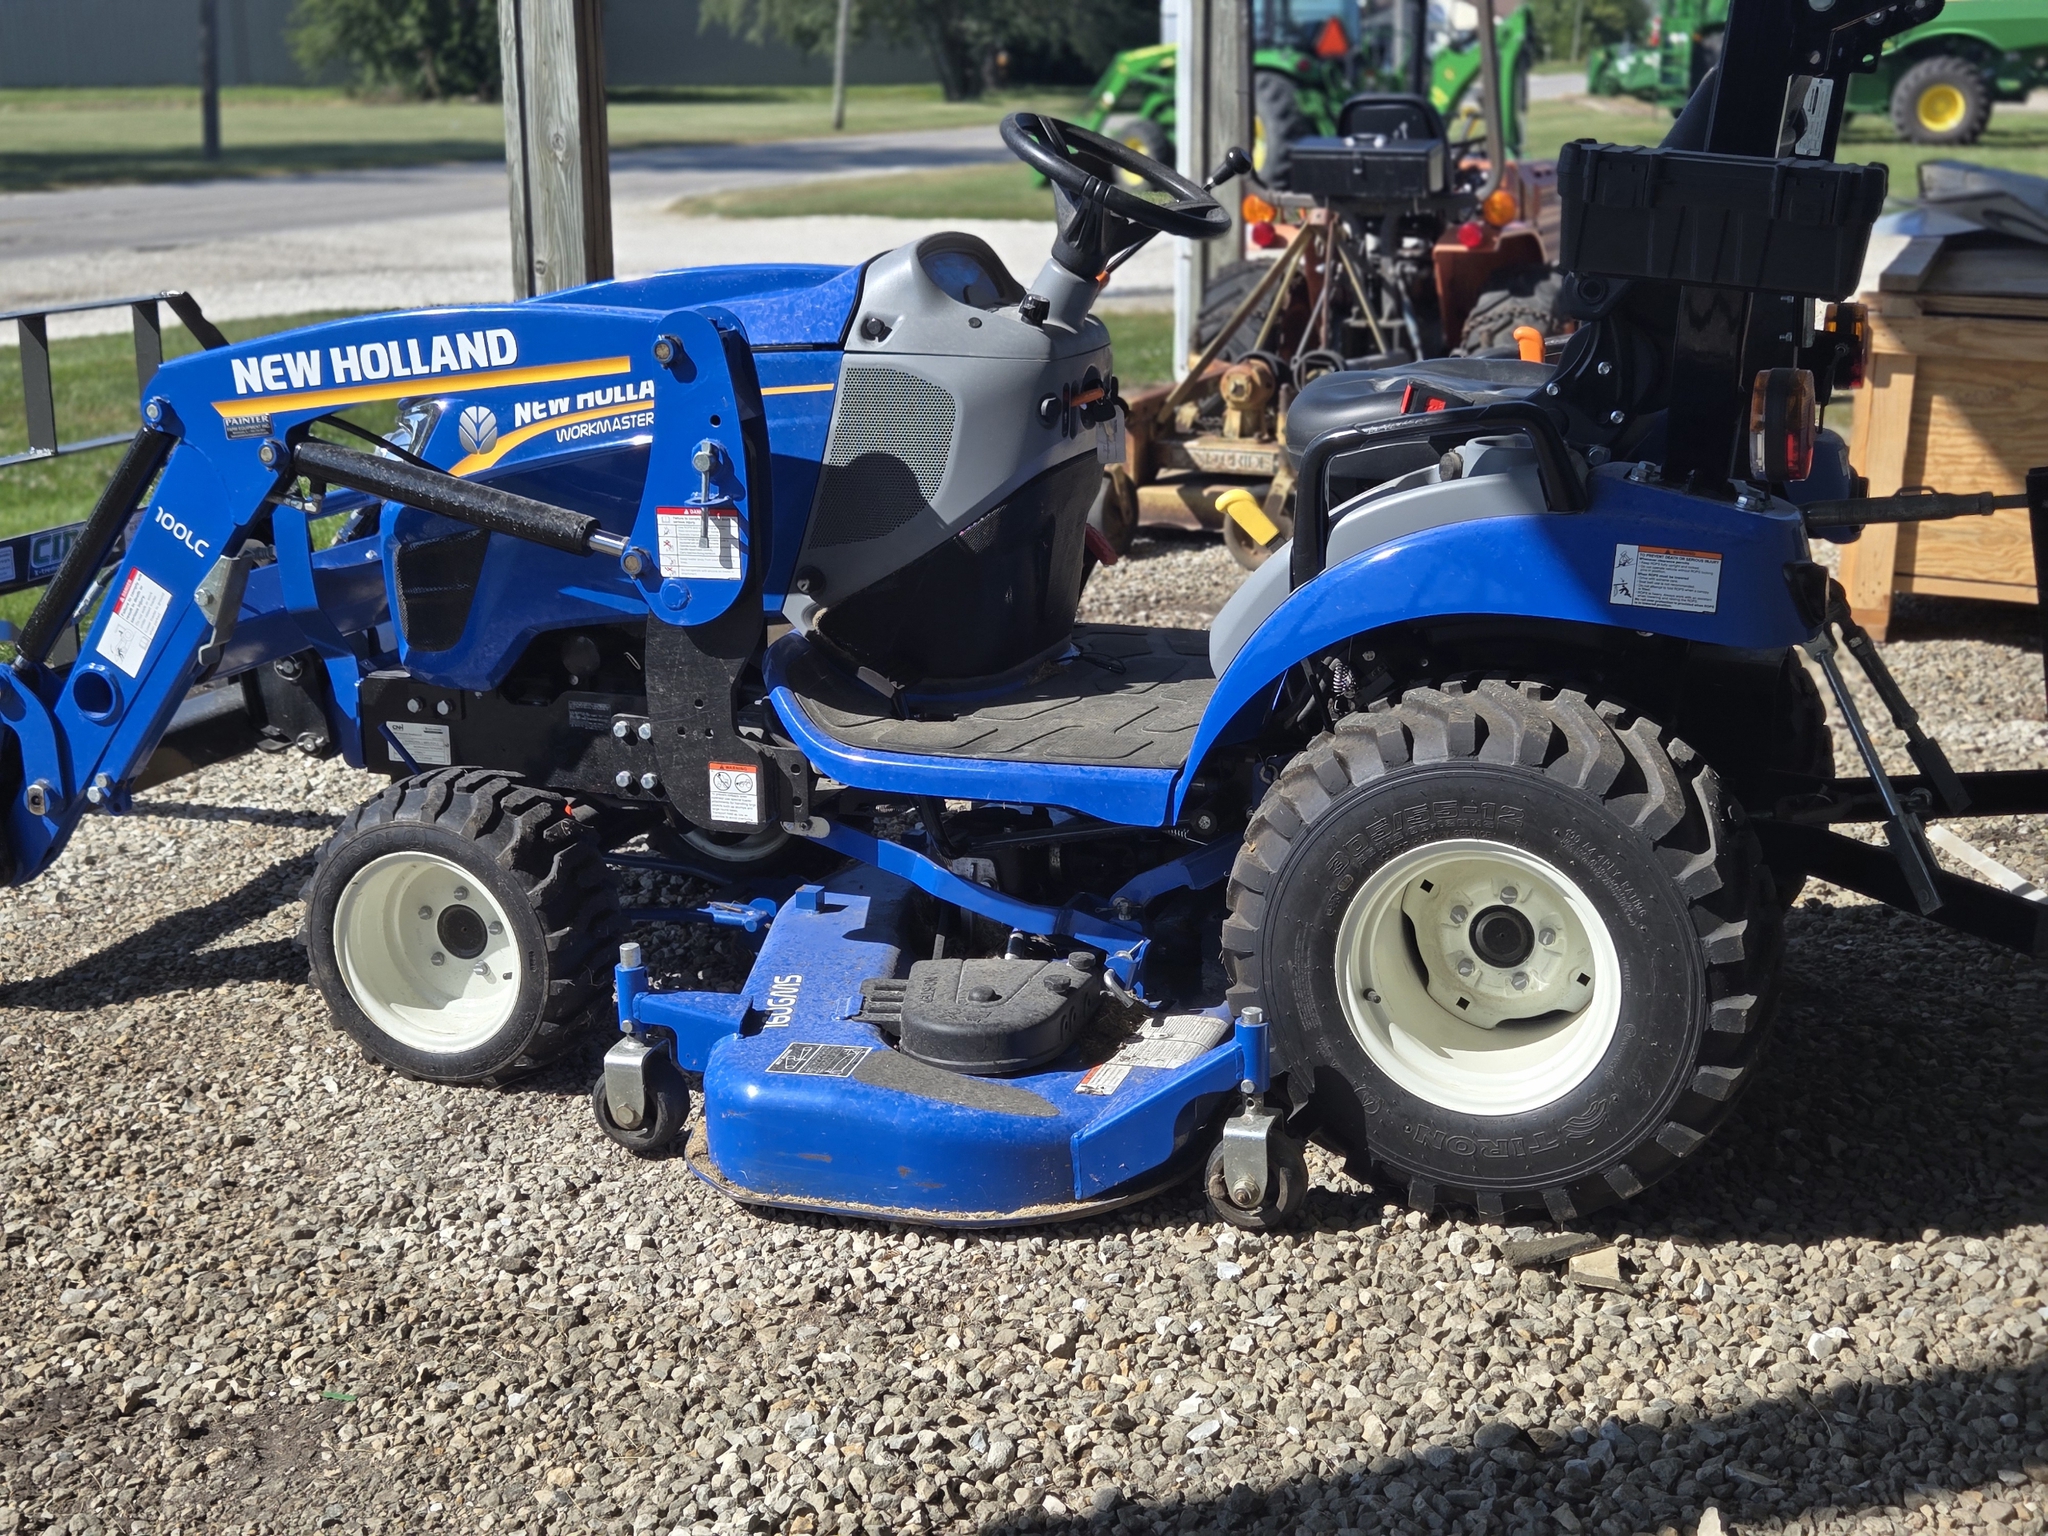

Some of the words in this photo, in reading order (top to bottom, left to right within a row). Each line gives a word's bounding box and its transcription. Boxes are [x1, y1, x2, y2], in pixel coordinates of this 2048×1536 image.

[231, 349, 321, 395] NEW
[329, 328, 518, 384] HOLLAND
[225, 414, 270, 426] PAINTER
[514, 396, 570, 427] NEW
[556, 412, 654, 443] WORKMASTER
[154, 505, 210, 558] 100LC
[1327, 799, 1526, 877] 305/55-12
[1616, 880, 1653, 918] RATING
[763, 973, 803, 1029] 160GMS
[1412, 1123, 1560, 1159] TIRON
